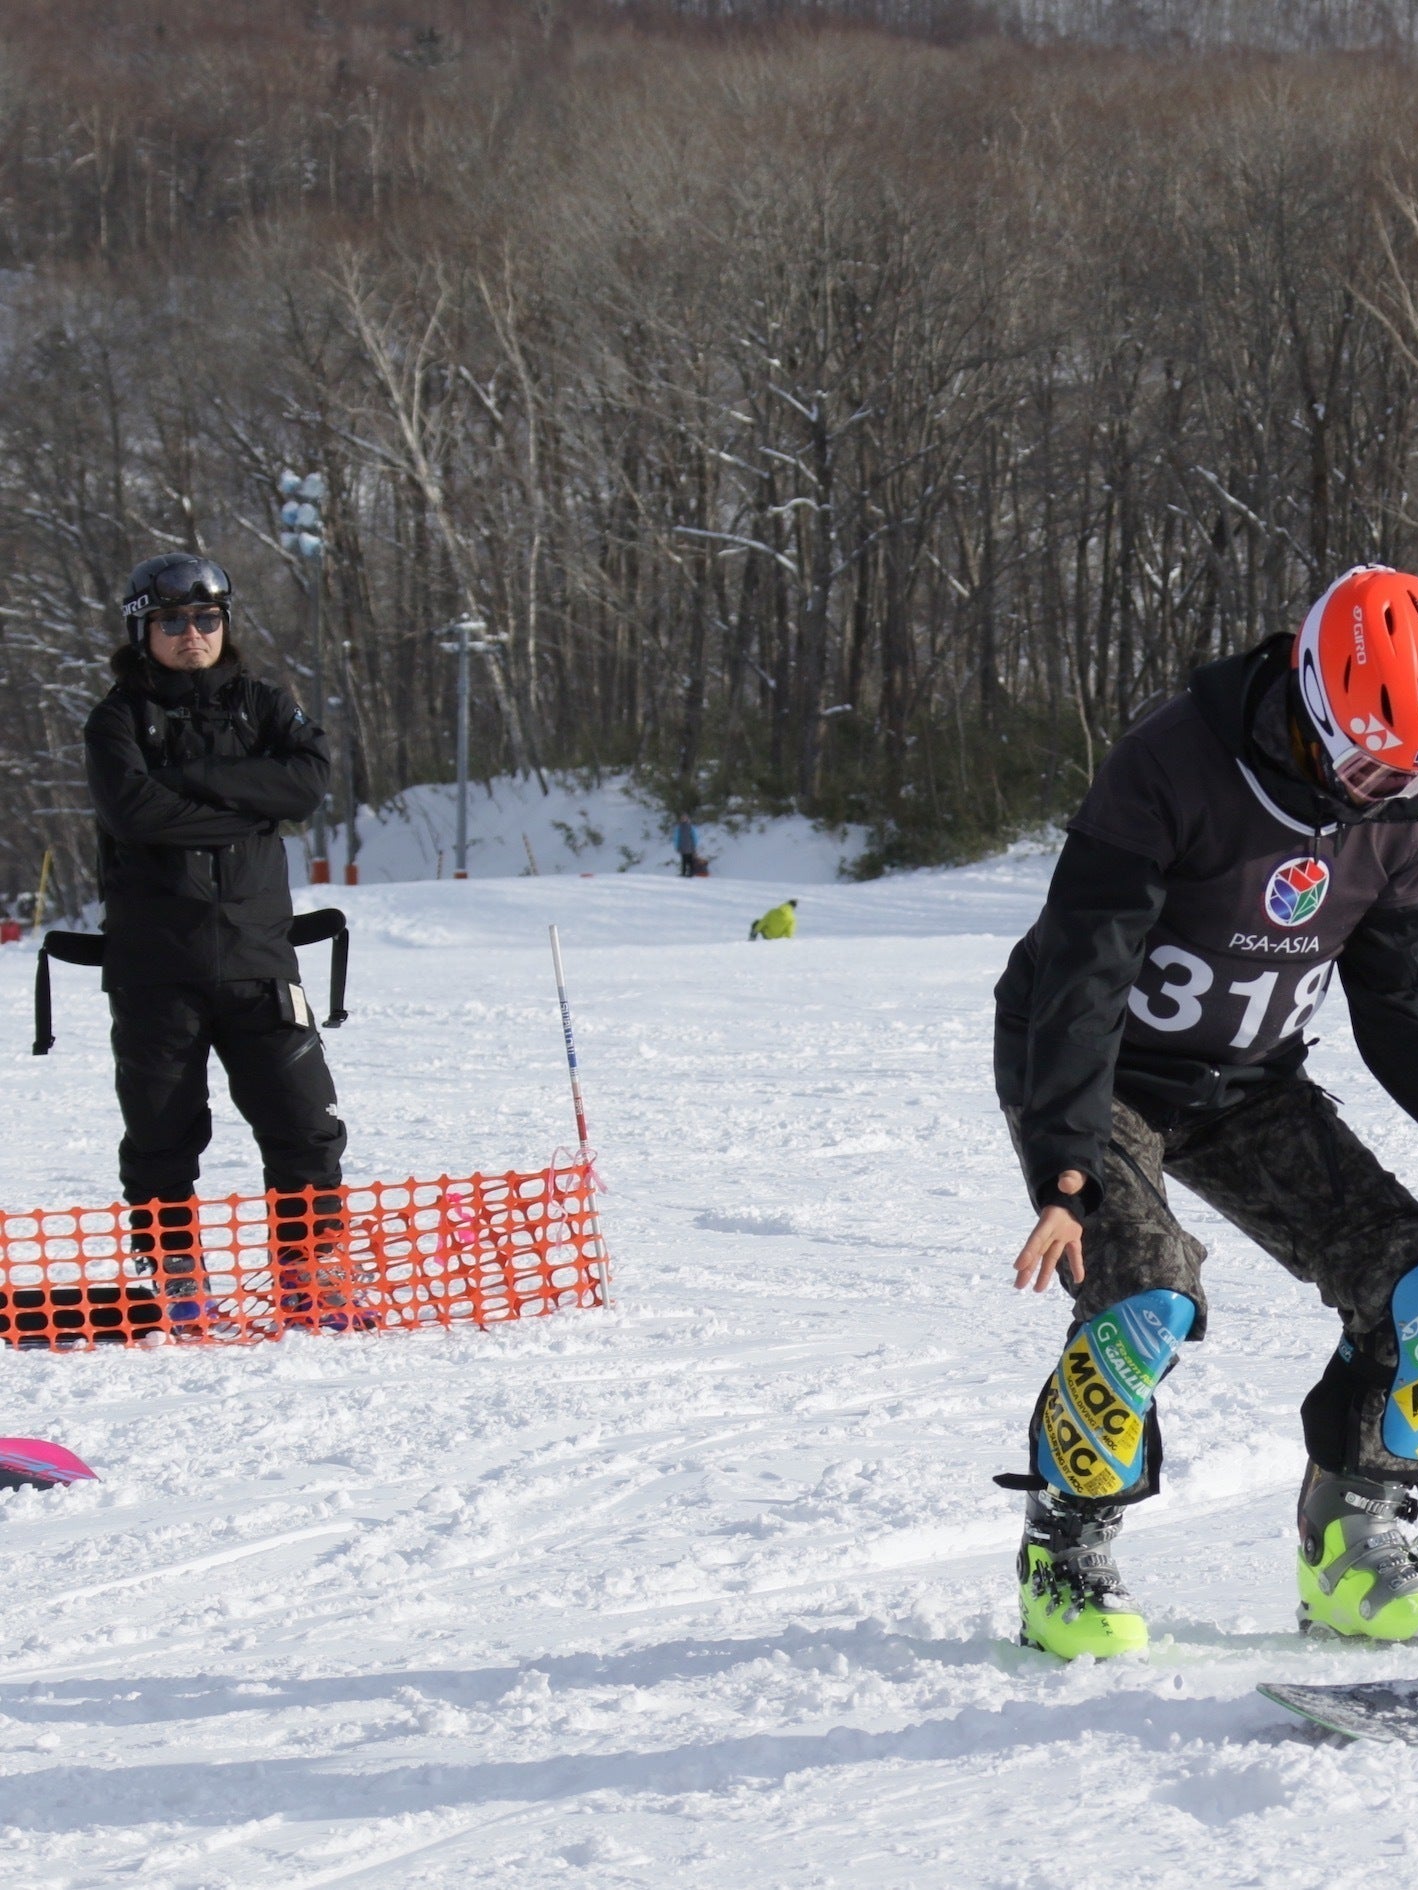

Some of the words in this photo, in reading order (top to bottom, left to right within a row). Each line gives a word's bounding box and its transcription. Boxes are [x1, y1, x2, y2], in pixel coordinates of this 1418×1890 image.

[1353, 623, 1367, 665] GIRO
[1228, 932, 1320, 954] PSA-ASIA
[1127, 944, 1334, 1049] 318
[1097, 1321, 1118, 1343] G
[1076, 1400, 1098, 1428] DIVING
